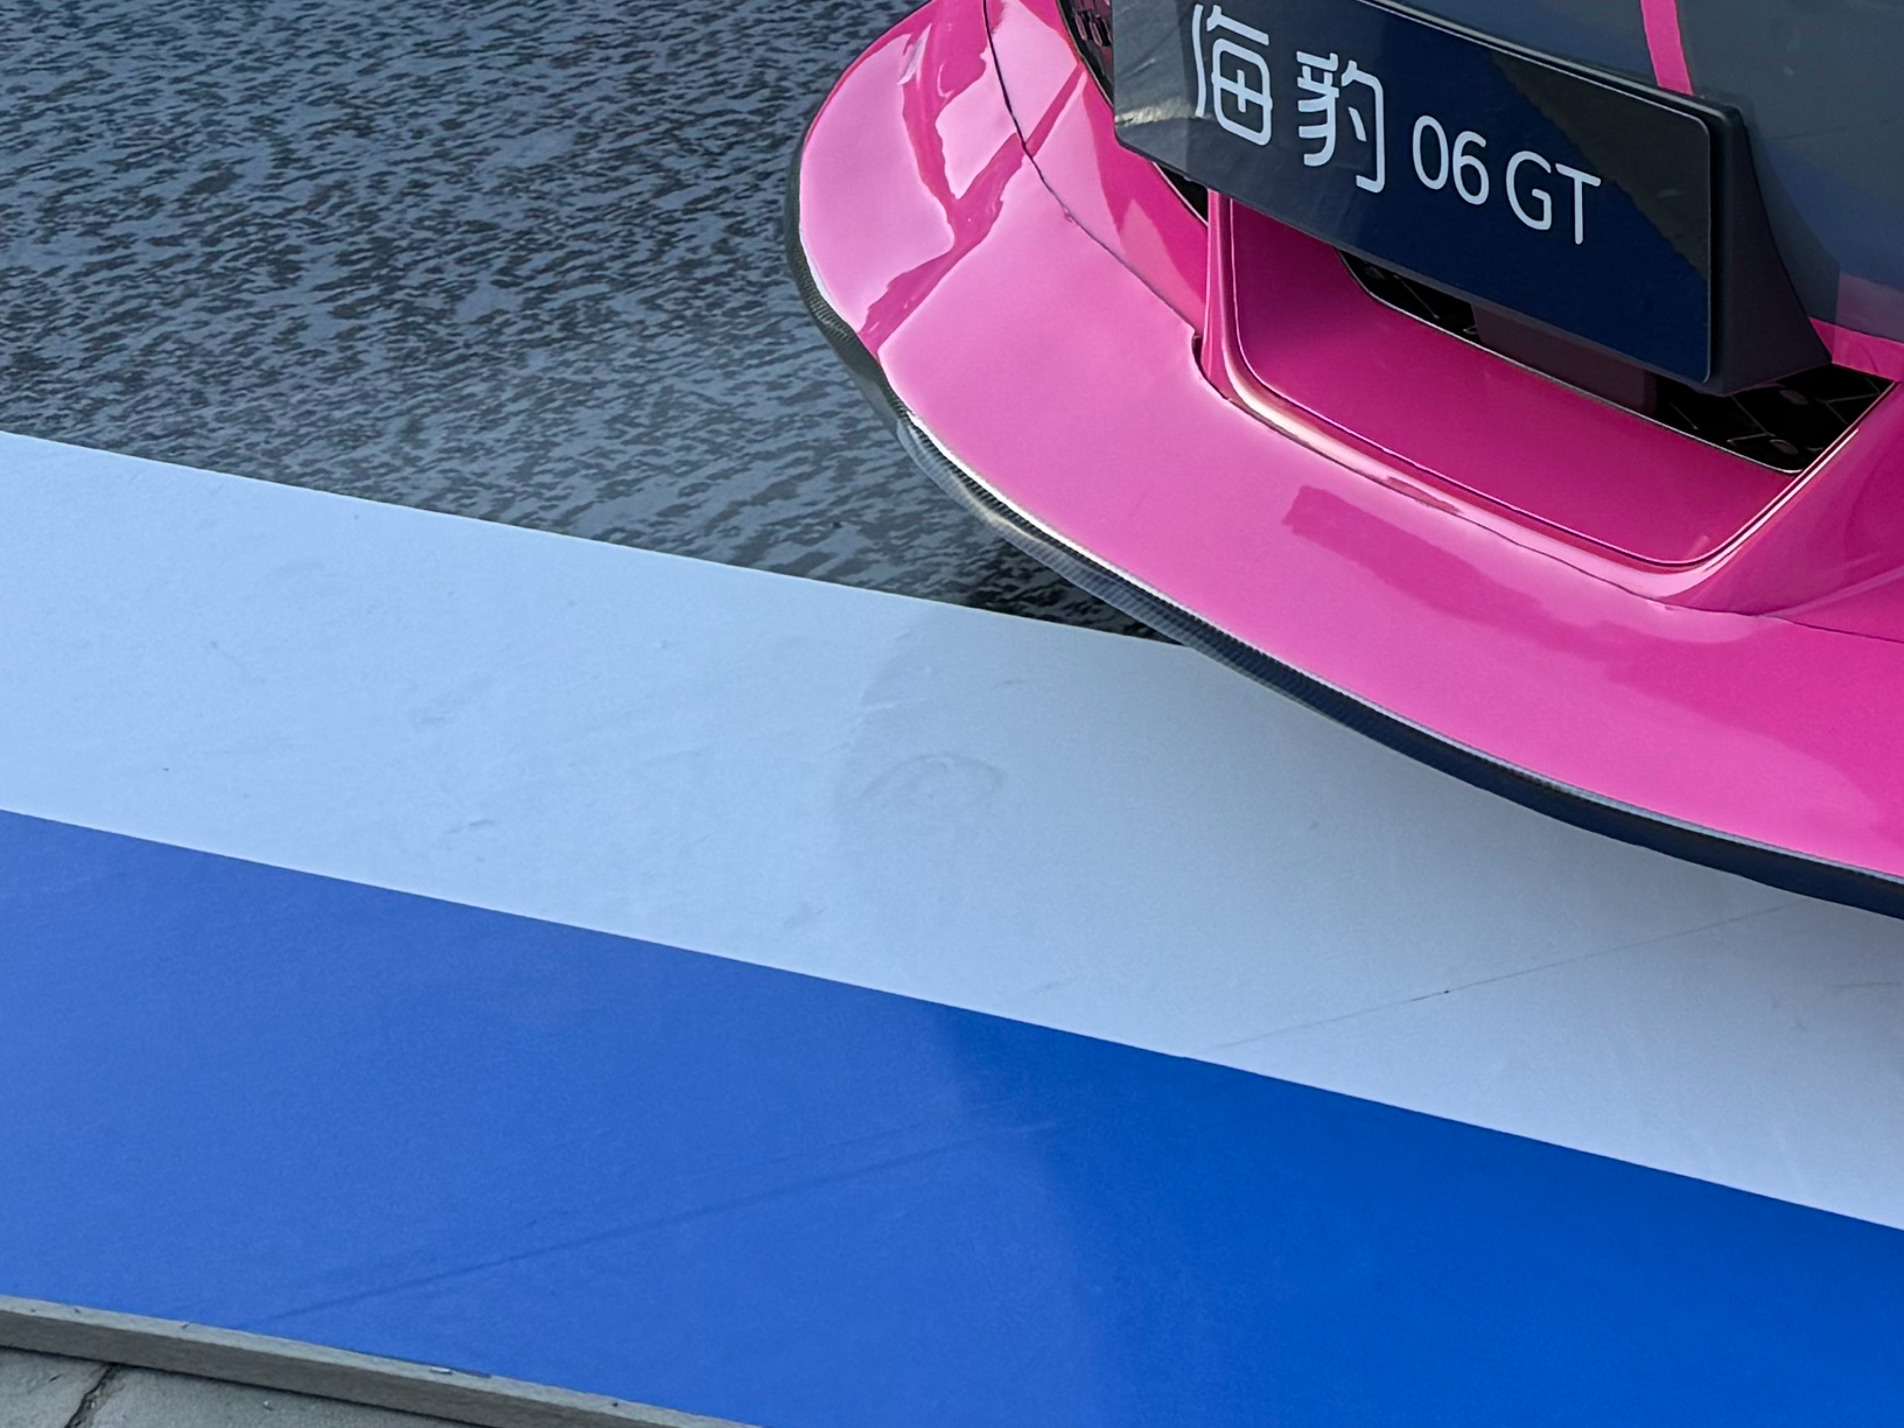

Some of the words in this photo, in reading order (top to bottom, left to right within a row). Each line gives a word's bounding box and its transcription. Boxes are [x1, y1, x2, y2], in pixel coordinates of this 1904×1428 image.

[1191, 4, 1386, 194] 海豹
[1411, 113, 1489, 208] 06
[1505, 151, 1601, 246] GT
